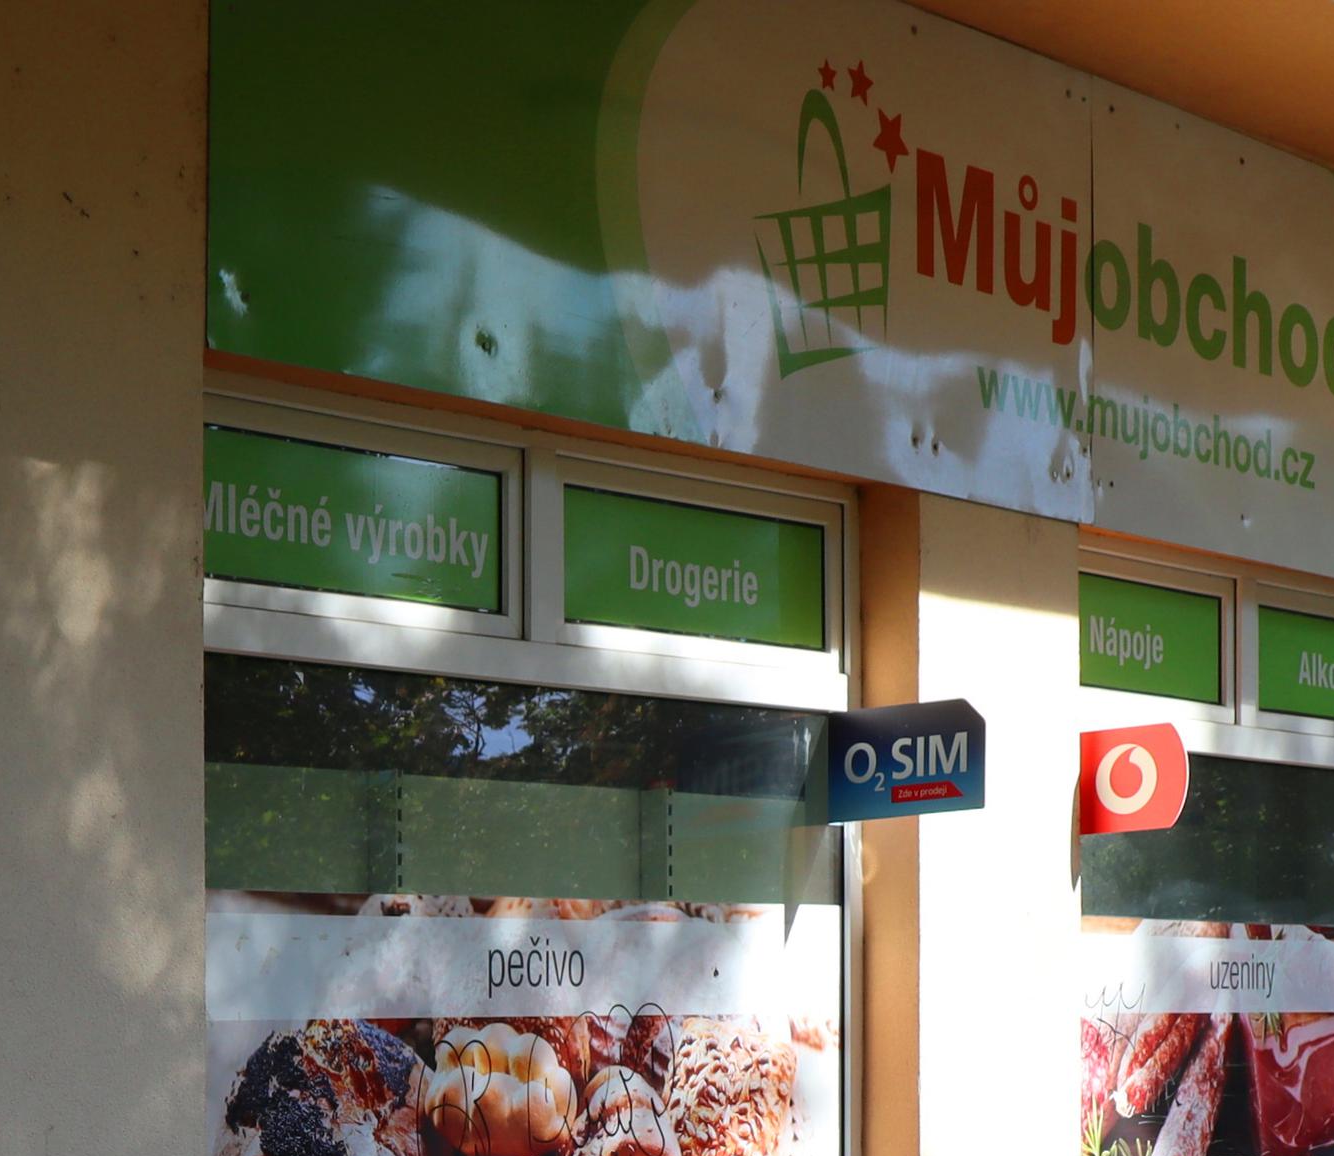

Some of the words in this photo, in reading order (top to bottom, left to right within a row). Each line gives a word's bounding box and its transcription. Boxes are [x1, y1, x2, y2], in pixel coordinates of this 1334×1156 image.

[977, 365, 1316, 490] www.mujobchod.cz
[345, 504, 489, 579] výrobky
[629, 545, 758, 608] Drogerie
[1089, 613, 1165, 670] Nápoje
[891, 731, 968, 780] SIM
[898, 789, 913, 799] Zde
[487, 938, 585, 998] pečivo
[1209, 954, 1276, 999] uzeniny
